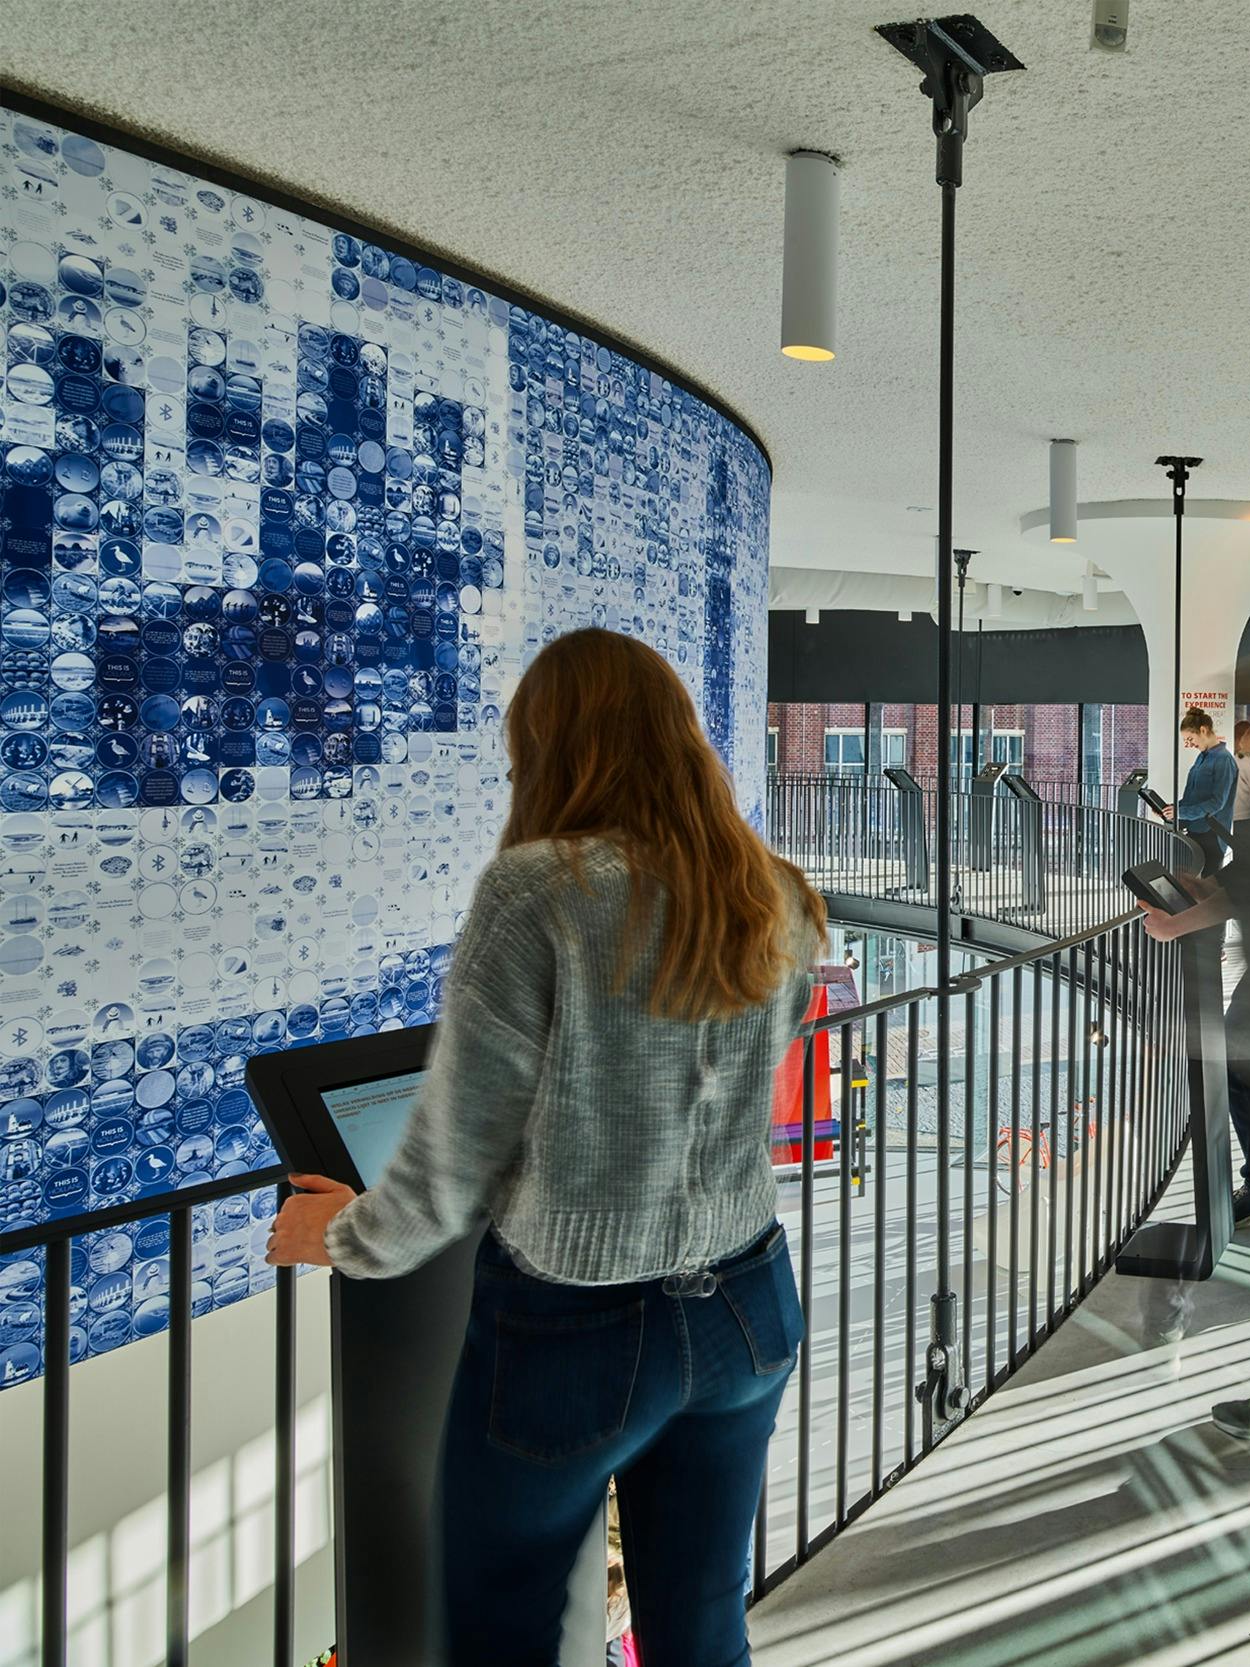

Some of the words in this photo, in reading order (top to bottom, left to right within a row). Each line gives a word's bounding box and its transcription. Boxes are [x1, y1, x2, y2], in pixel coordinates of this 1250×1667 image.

[101, 1128, 117, 1136] THIS
[54, 1178, 71, 1187] THIS
[71, 1176, 79, 1184] IS
